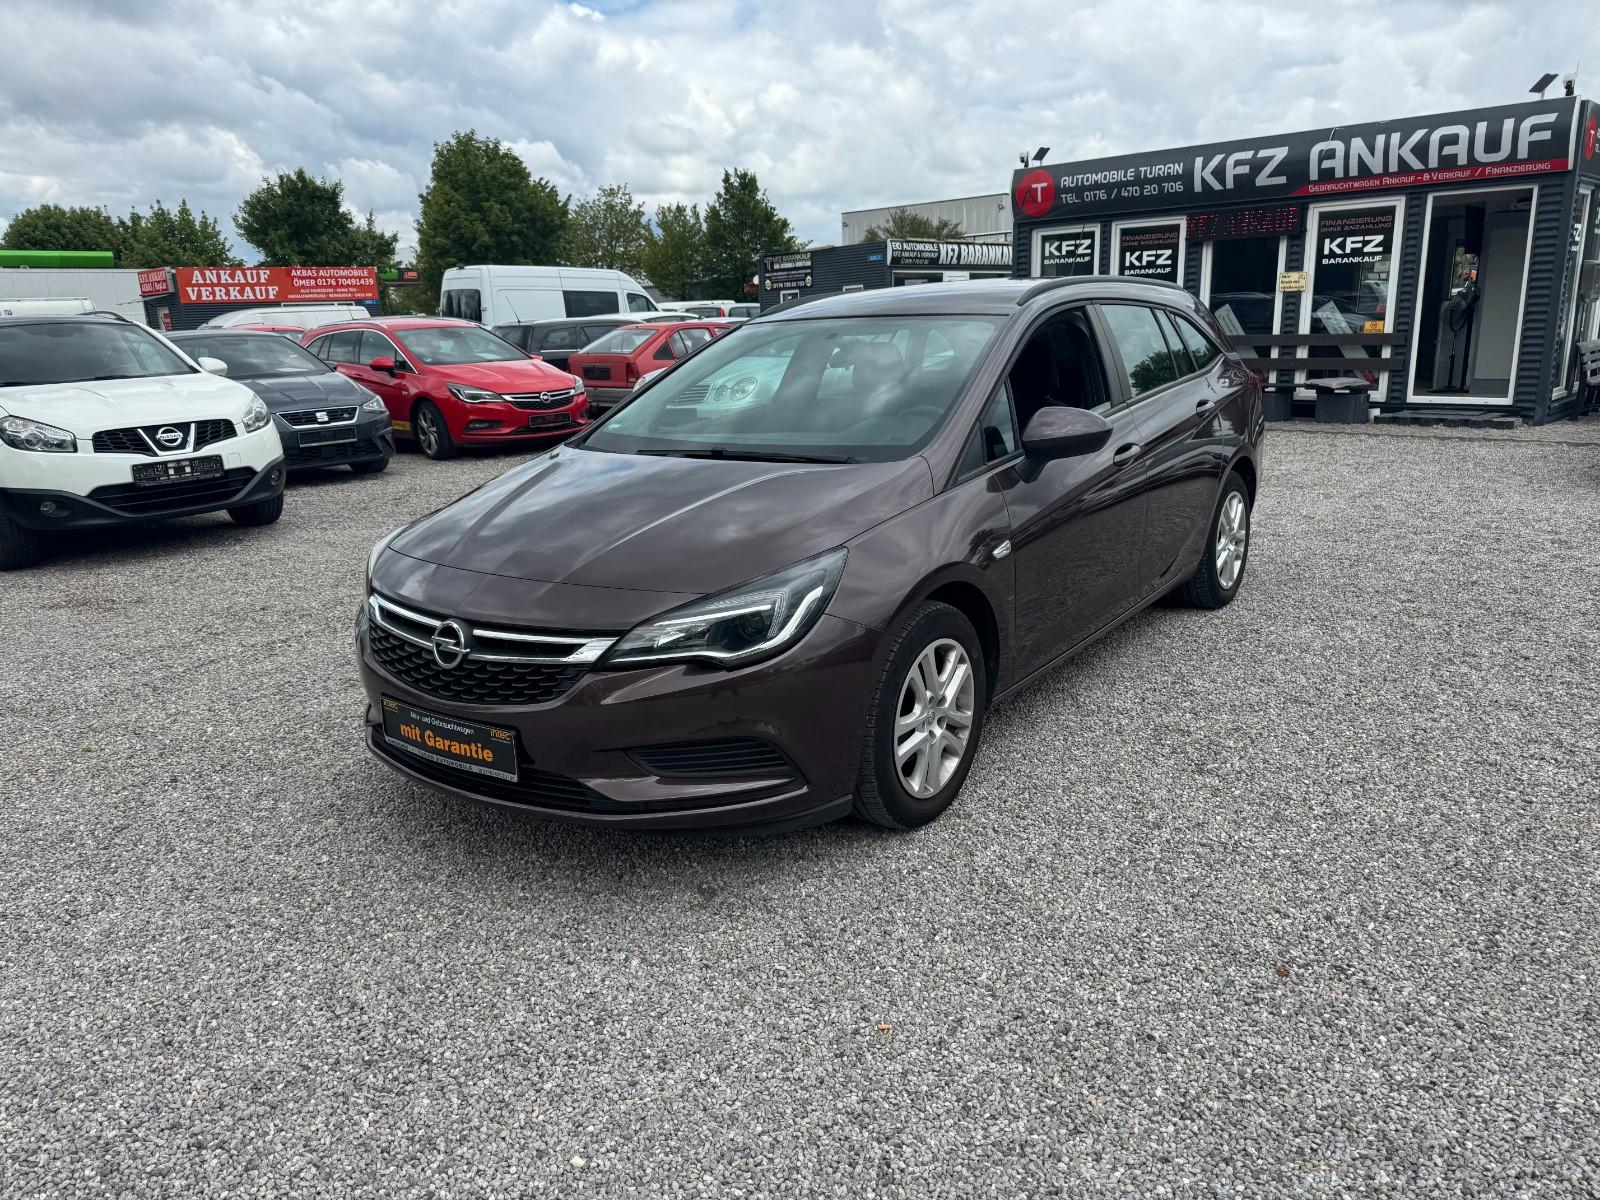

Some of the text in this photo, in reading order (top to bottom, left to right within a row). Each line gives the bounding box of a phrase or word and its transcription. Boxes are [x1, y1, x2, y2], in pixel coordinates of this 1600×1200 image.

[1194, 146, 1289, 193] KFZ
[1309, 112, 1559, 181] ANKAUF
[1060, 162, 1184, 189] AUTOMOBILE TURAN
[1060, 193, 1083, 205] TEL.
[1084, 190, 1107, 202] 0176
[1121, 186, 1140, 198] 470
[1143, 184, 1158, 196] 20
[1161, 181, 1184, 194] 706
[1320, 215, 1393, 226] FINANZIERUNG
[1320, 225, 1342, 233] OHNE
[1045, 238, 1092, 257] KFZ
[1323, 234, 1385, 256] KFZ
[939, 243, 959, 265] KFZ
[1043, 256, 1091, 265] BARANKAUF
[1125, 249, 1172, 267] KFZ
[1322, 255, 1384, 265] BARANKAUF
[192, 270, 271, 284] ANKAUF
[291, 269, 369, 278] AKBAS AUTOMOBILE
[1124, 267, 1172, 276] BARANKAUF
[293, 277, 375, 287] ÖMER 0176 70491439
[186, 286, 279, 301] VERKAUF
[400, 722, 421, 742] mit
[424, 730, 495, 762] Garantie
